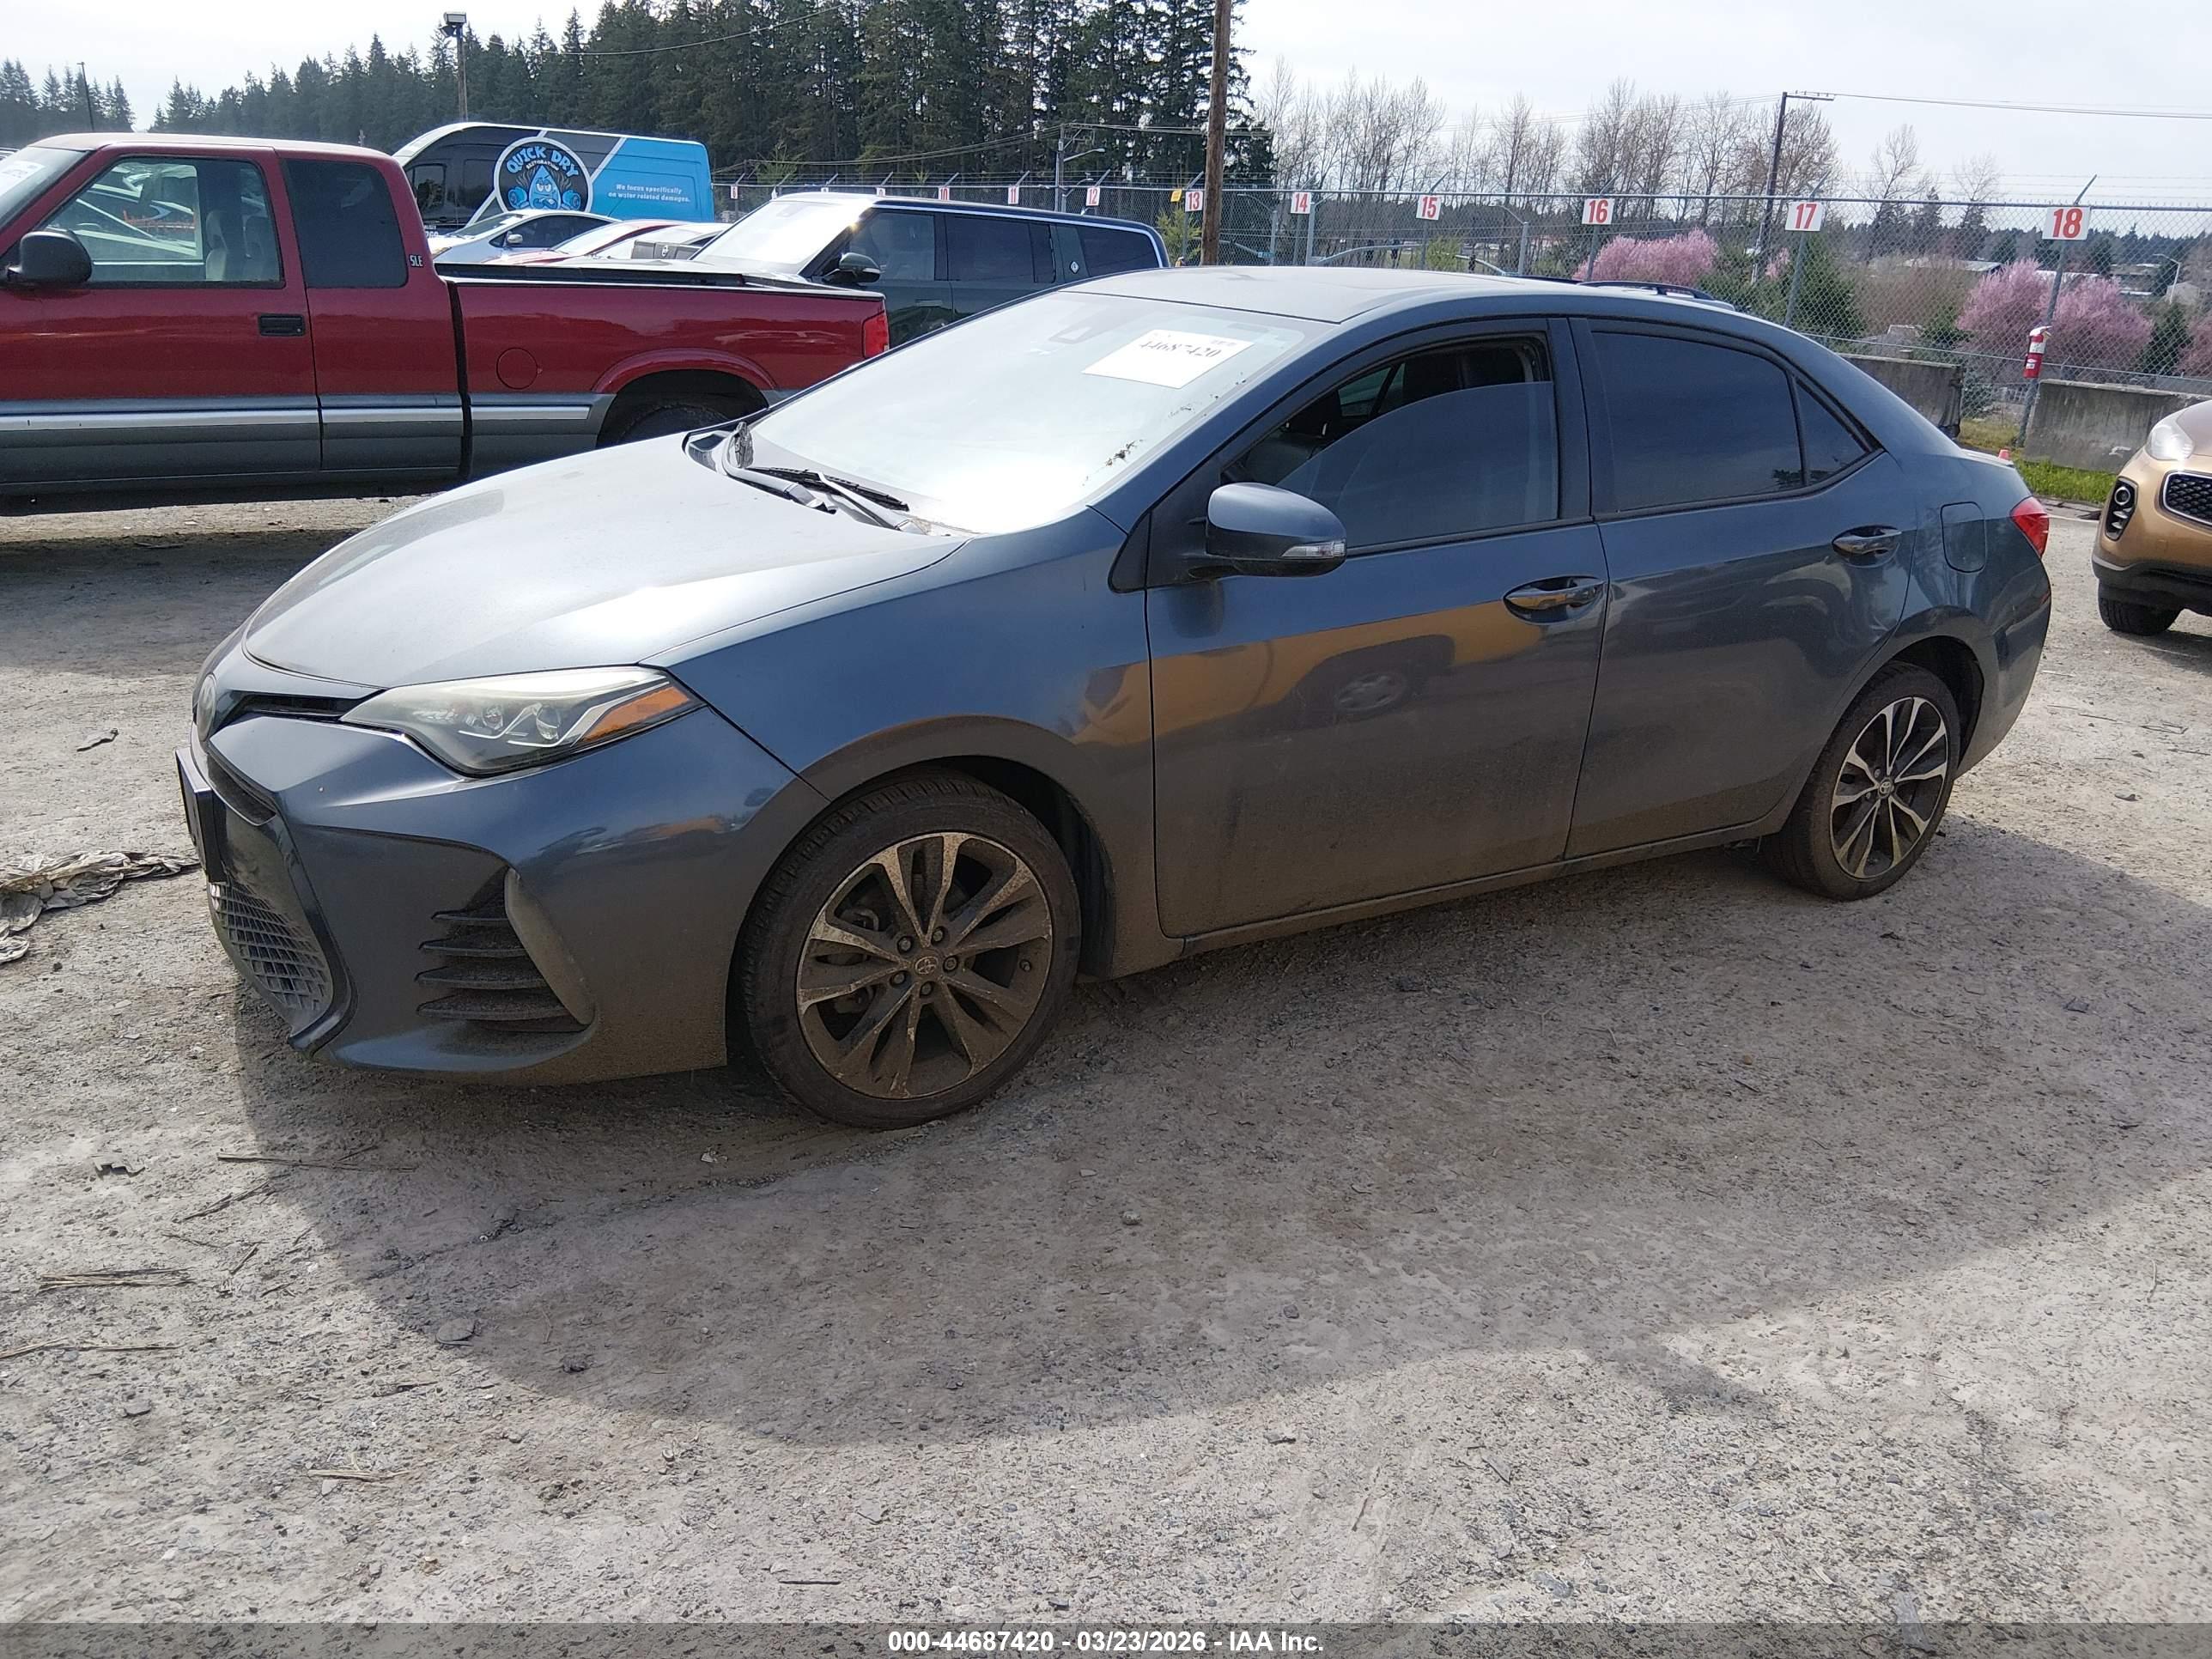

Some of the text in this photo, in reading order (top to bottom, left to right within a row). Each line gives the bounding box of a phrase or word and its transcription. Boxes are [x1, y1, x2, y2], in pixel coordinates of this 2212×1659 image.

[506, 146, 580, 178] QUICK DRY
[645, 185, 683, 195] specifically
[940, 188, 948, 200] 10
[1010, 187, 1017, 203] 11
[1088, 188, 1098, 205] 12
[1188, 191, 1200, 210] 13
[1295, 192, 1308, 212] 14
[1421, 196, 1437, 218] 15
[1589, 199, 1608, 223] 16
[1795, 203, 1818, 229] 17
[2052, 208, 2083, 239] 18
[410, 254, 424, 267] SLE
